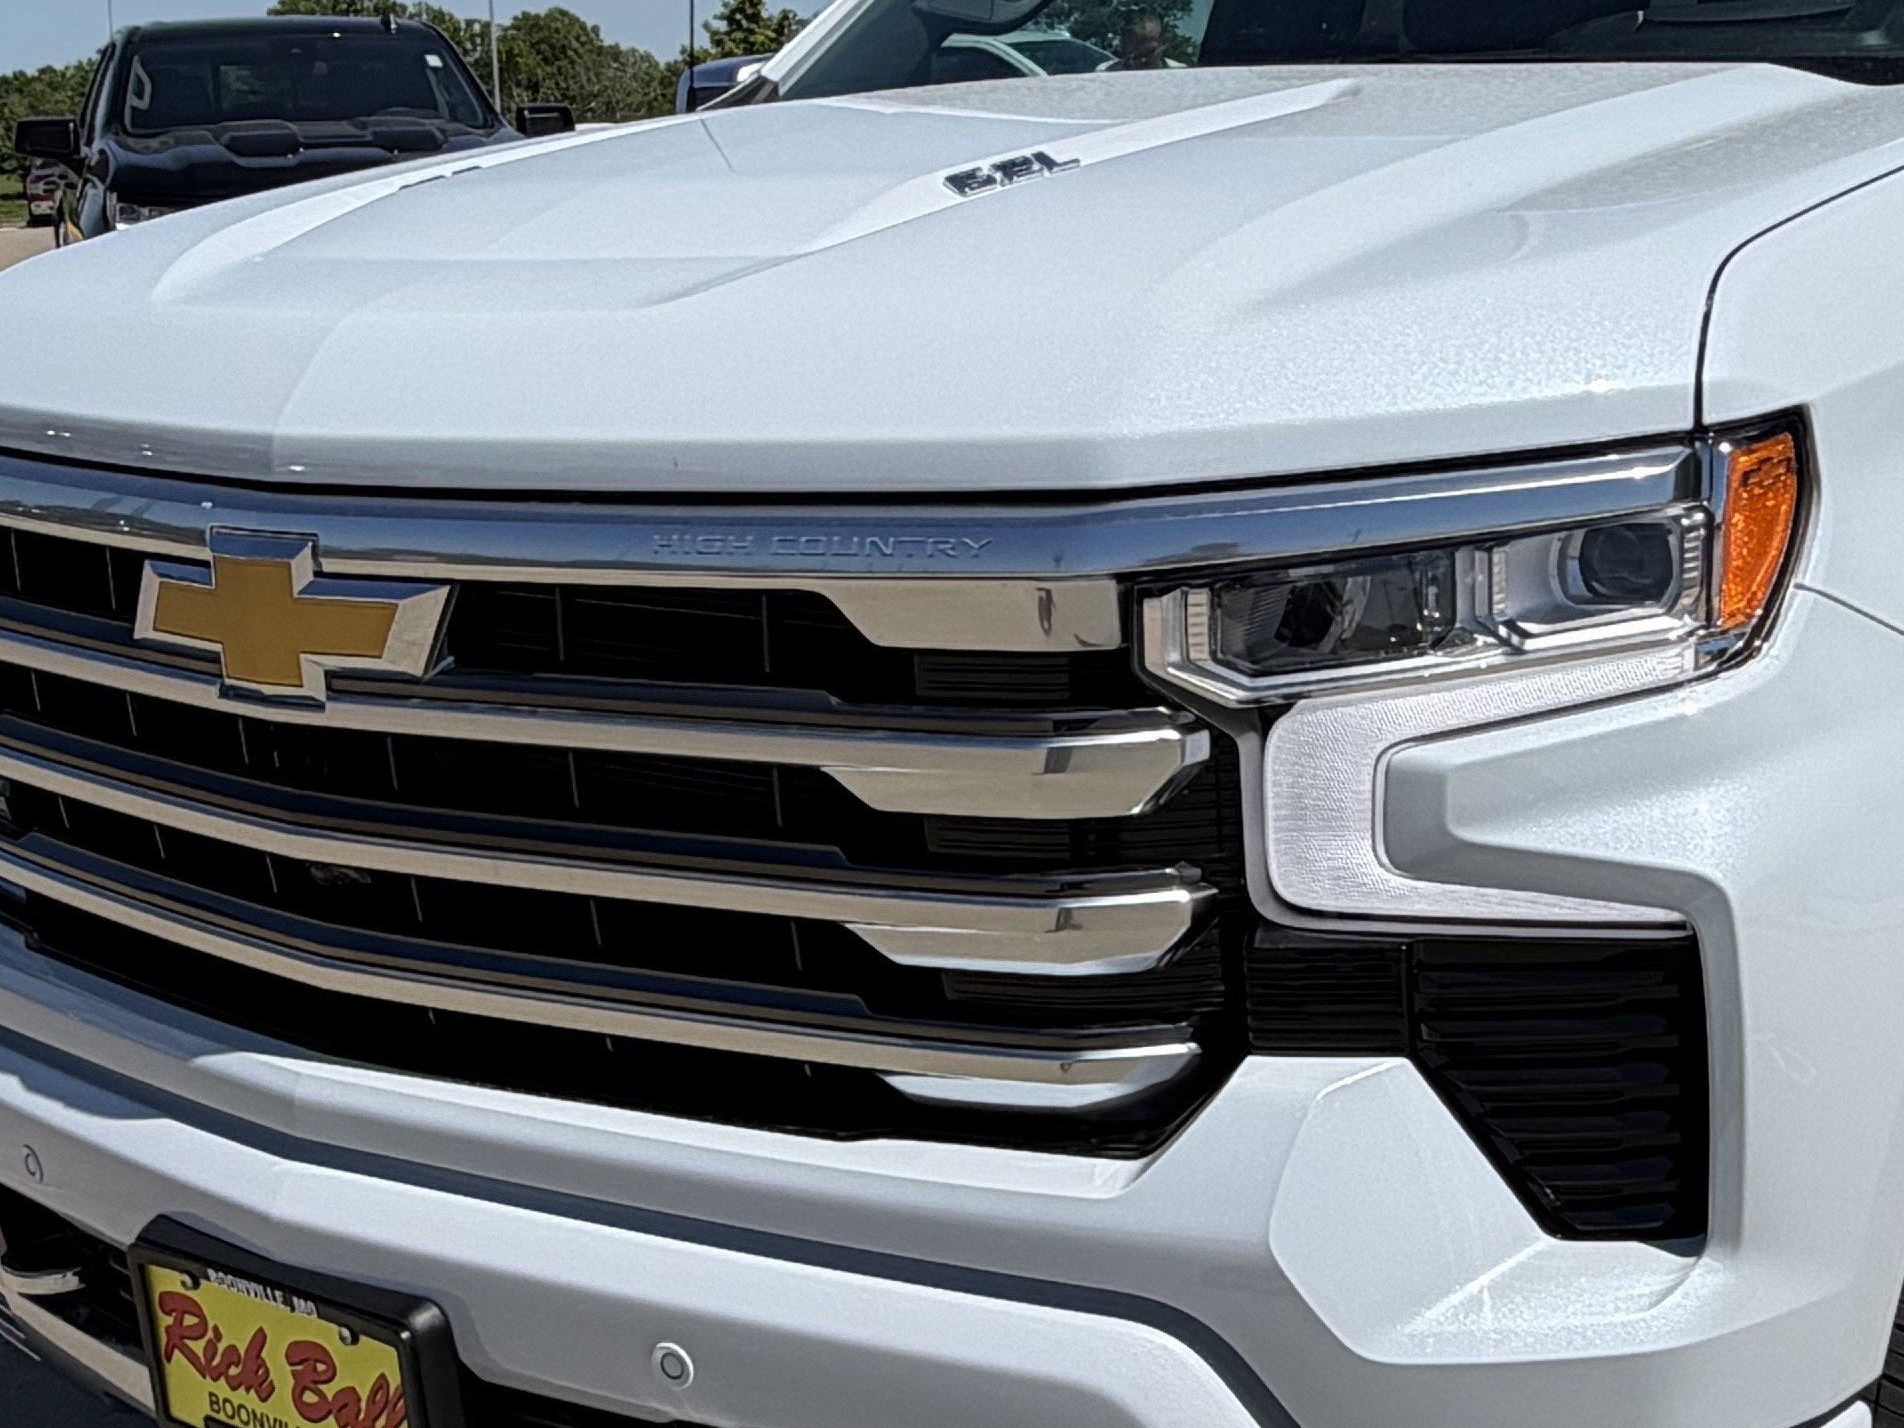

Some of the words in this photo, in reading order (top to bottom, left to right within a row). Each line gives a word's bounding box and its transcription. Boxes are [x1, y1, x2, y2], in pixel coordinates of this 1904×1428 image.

[652, 534, 755, 557] HIGH
[769, 535, 992, 559] COUNTRY
[158, 1290, 276, 1403] Rick
